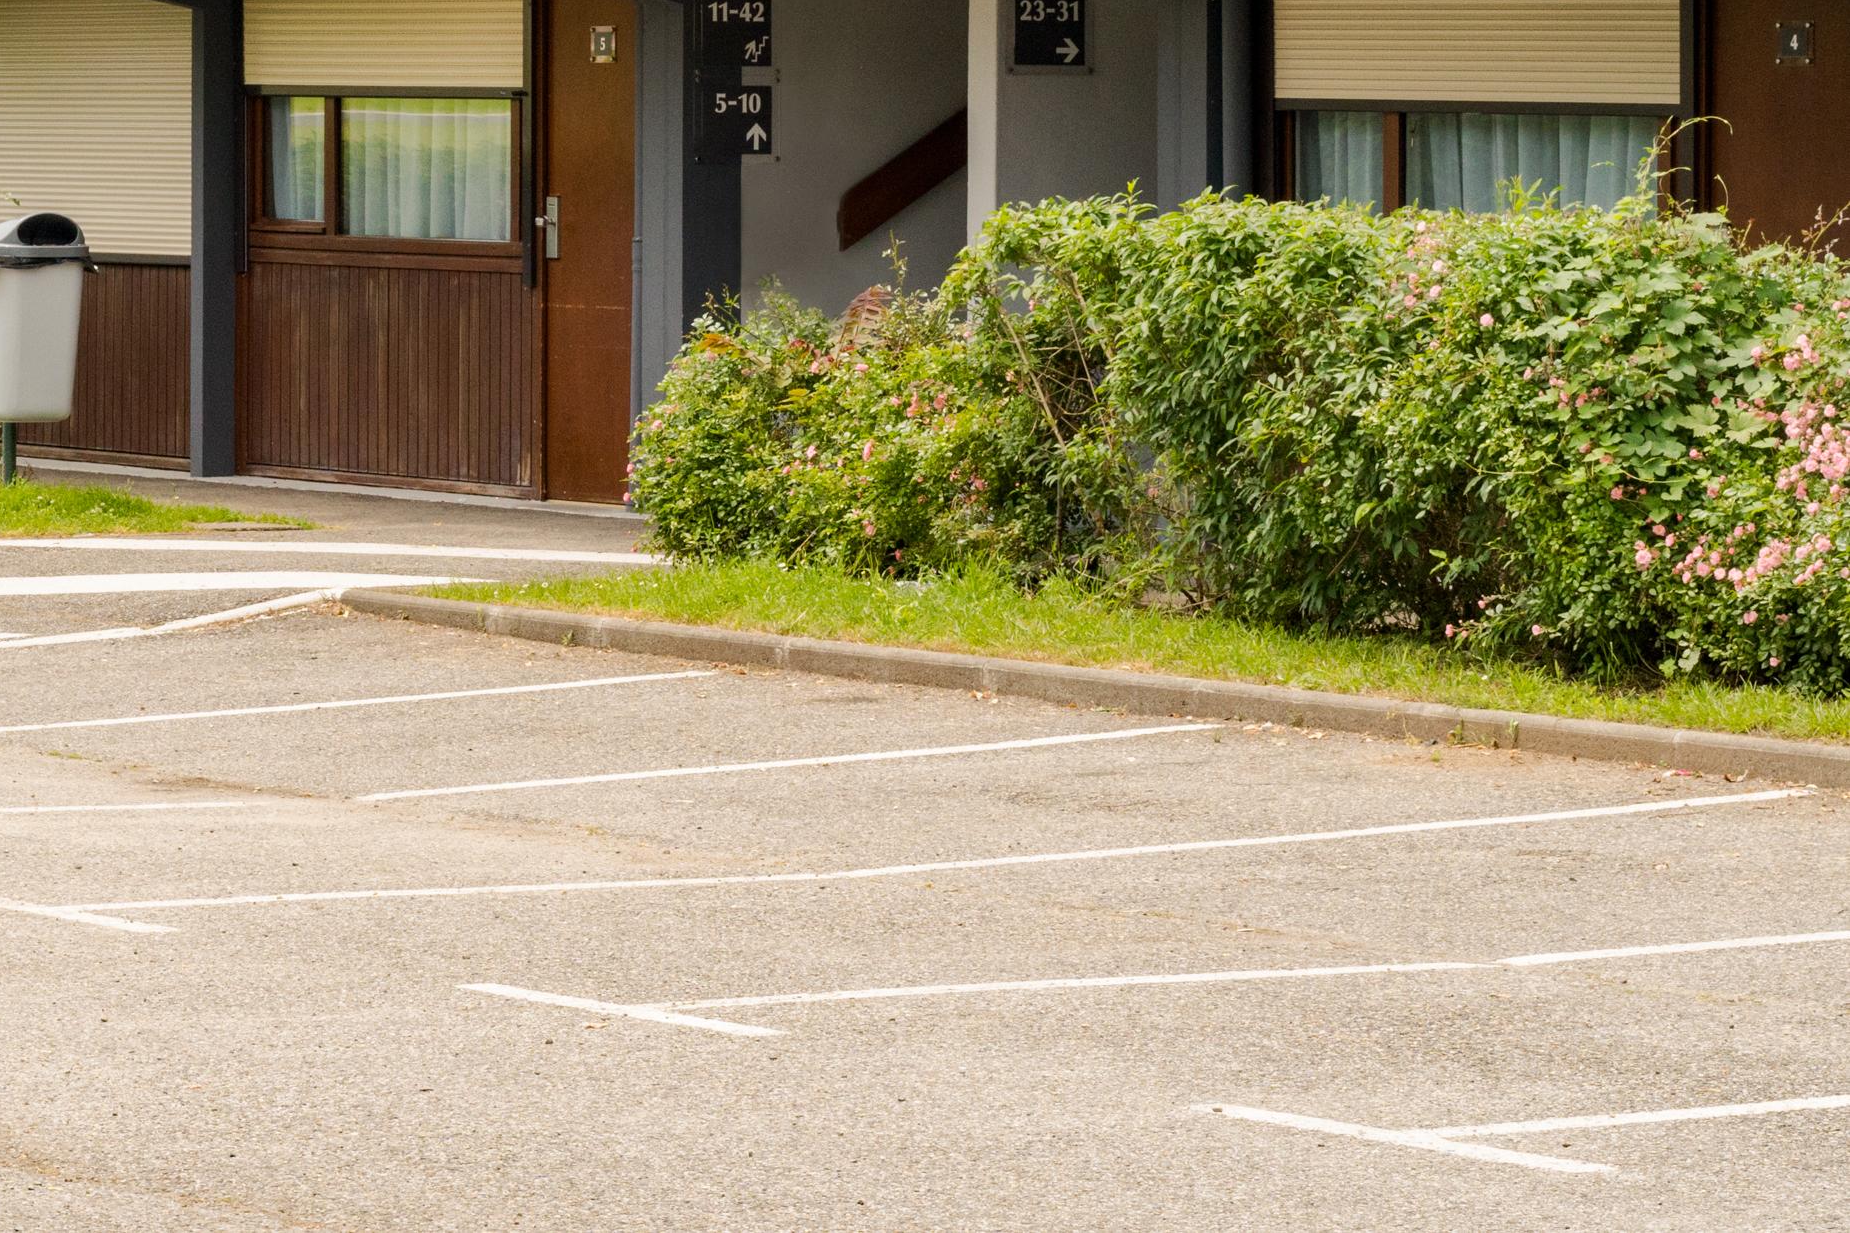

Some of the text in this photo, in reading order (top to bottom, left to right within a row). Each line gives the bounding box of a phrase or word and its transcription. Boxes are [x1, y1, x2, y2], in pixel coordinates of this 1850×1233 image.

[708, 1, 765, 23] 11-42
[1020, 0, 1079, 22] 23-31
[599, 37, 606, 51] 5
[1789, 34, 1799, 50] 4
[714, 92, 762, 114] 5-10
